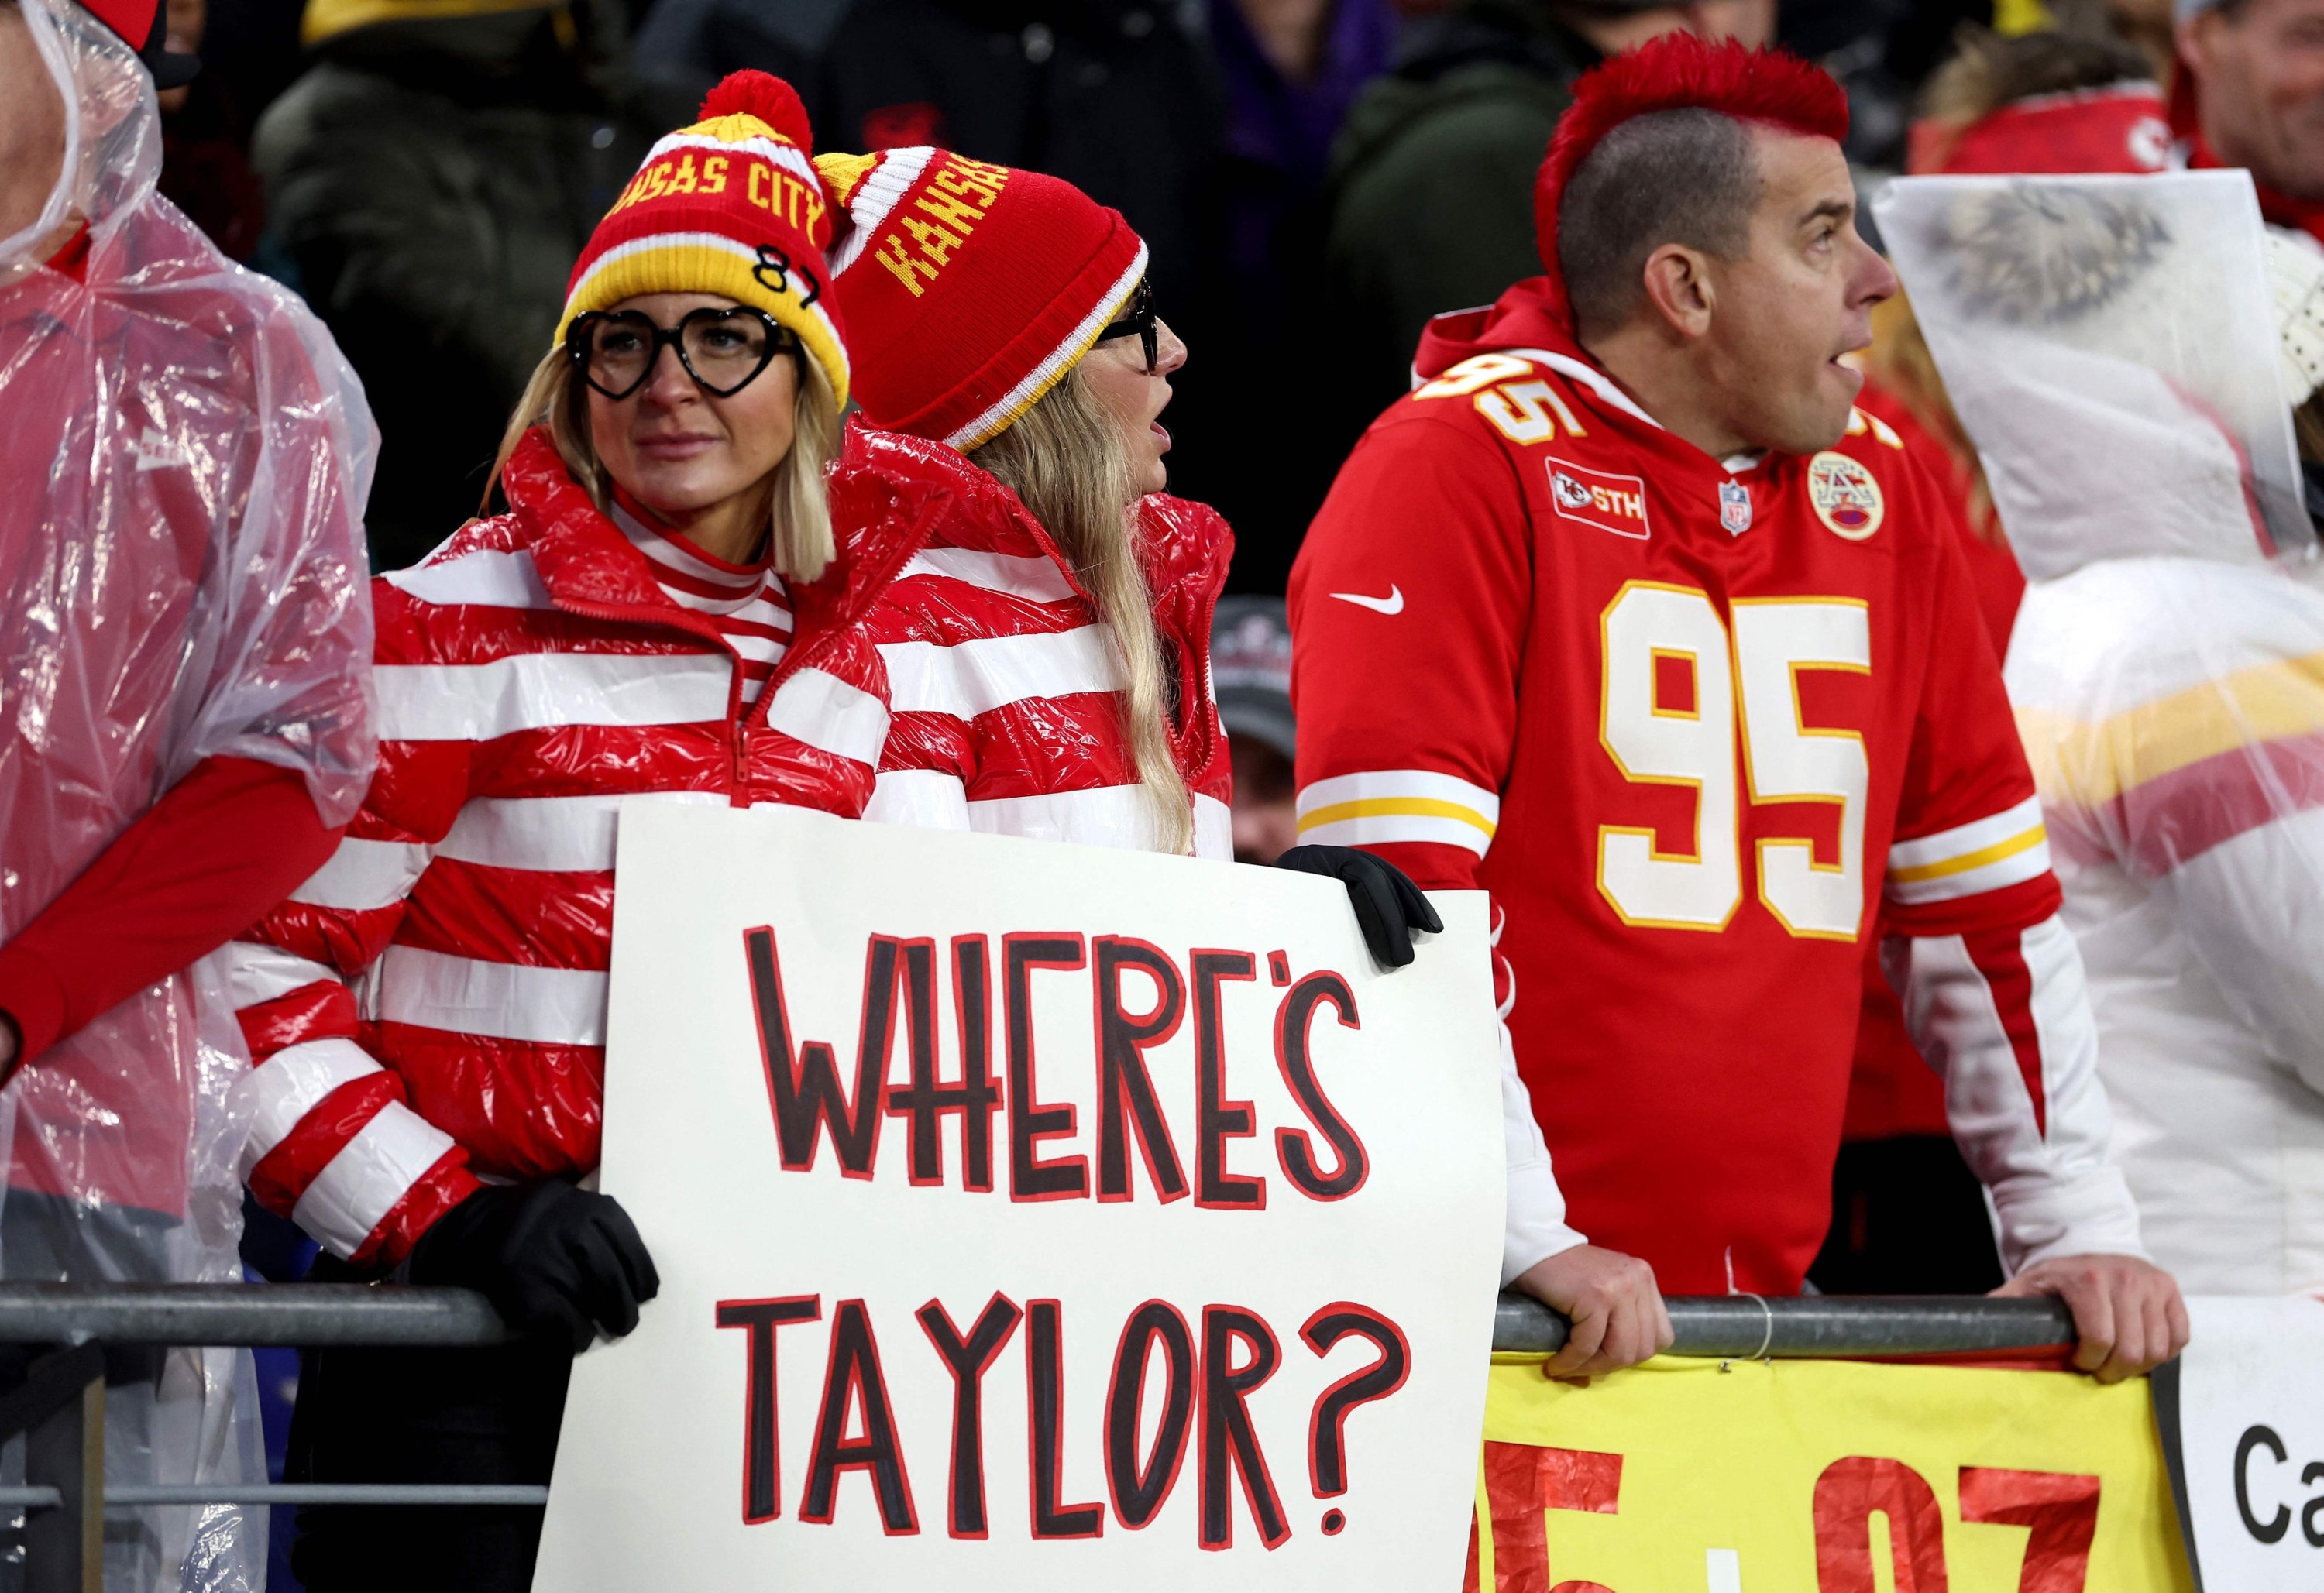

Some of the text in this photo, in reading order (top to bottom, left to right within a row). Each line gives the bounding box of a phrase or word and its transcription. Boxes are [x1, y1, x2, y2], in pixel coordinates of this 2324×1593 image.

[748, 162, 825, 246] CITY
[875, 153, 1009, 297] KANSAS
[752, 243, 820, 310] 87
[1412, 353, 1588, 447] 95
[1591, 484, 1644, 520] STH
[1596, 578, 1871, 942] 95
[741, 925, 1370, 1210] WHERE'S
[714, 1290, 1411, 1551] TAYLOR?
